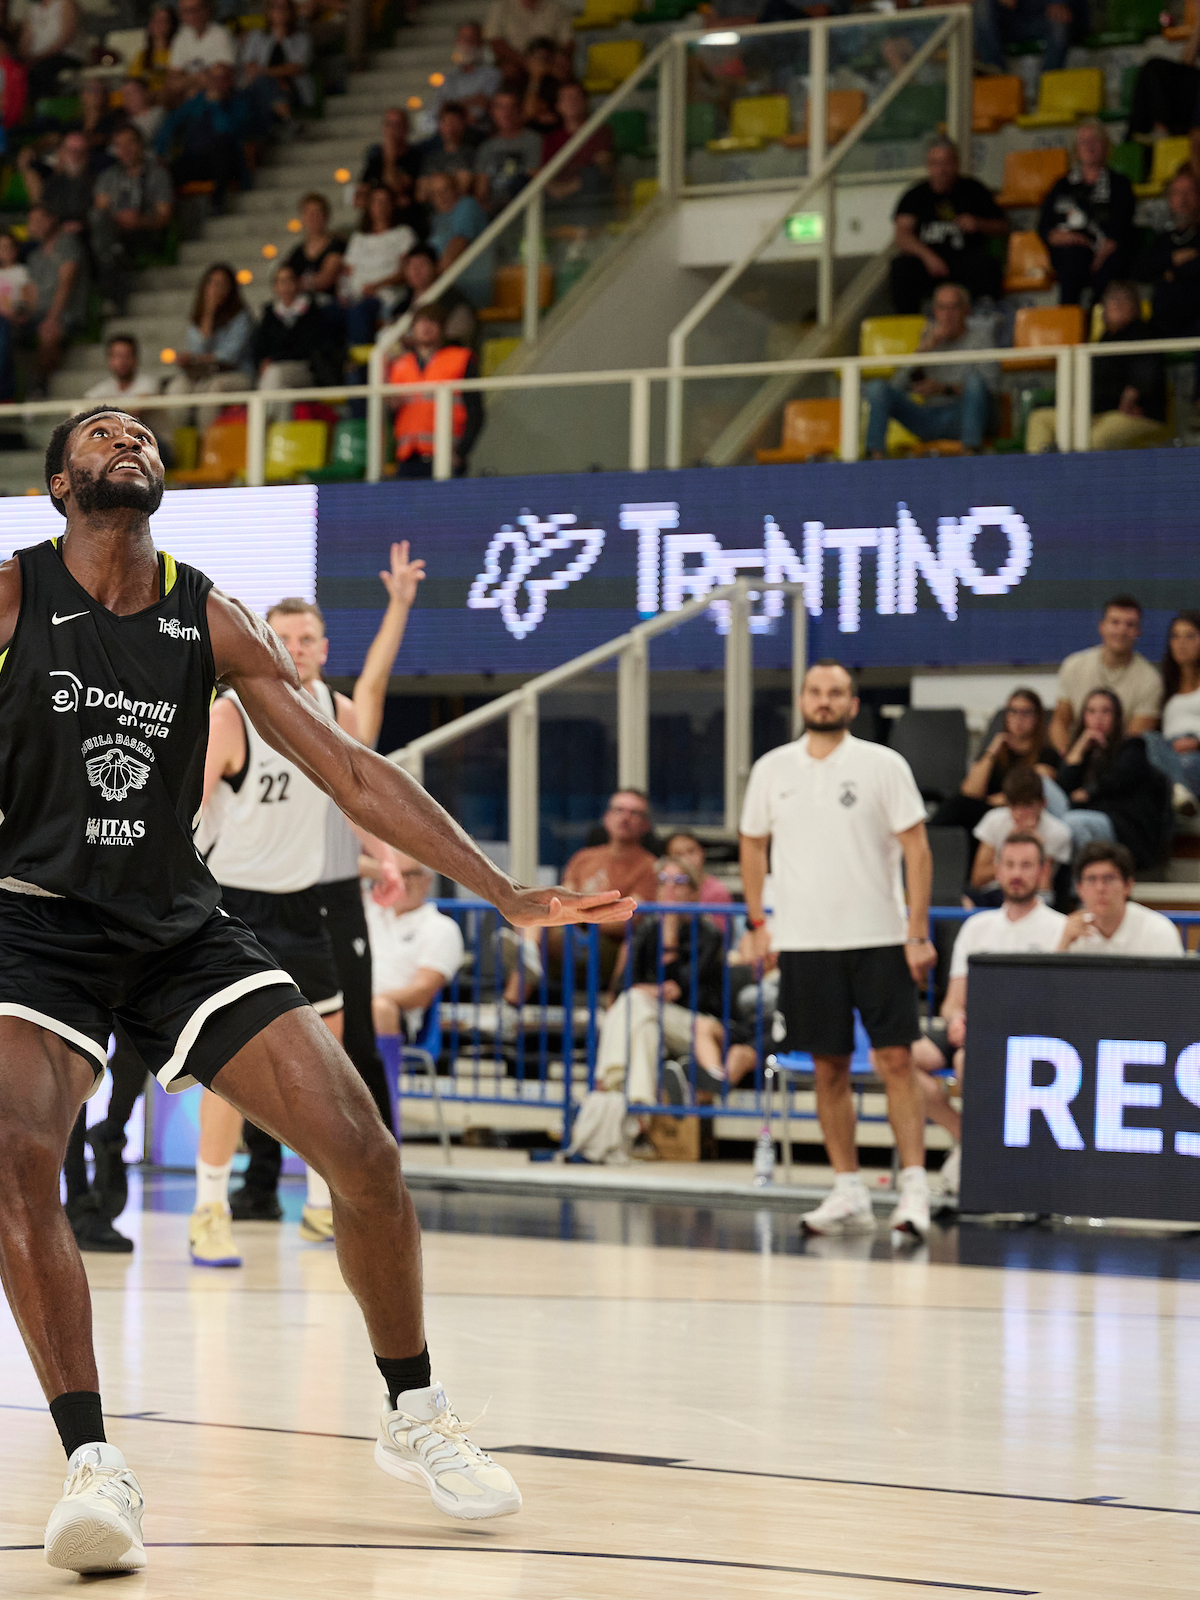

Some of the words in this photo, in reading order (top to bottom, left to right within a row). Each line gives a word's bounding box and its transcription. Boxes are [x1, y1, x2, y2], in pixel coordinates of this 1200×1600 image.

[85, 687, 178, 723] Dolomiti
[117, 714, 170, 738] enrgia
[260, 772, 290, 803] 22
[101, 819, 146, 838] ITAS
[100, 837, 134, 846] MUTUA
